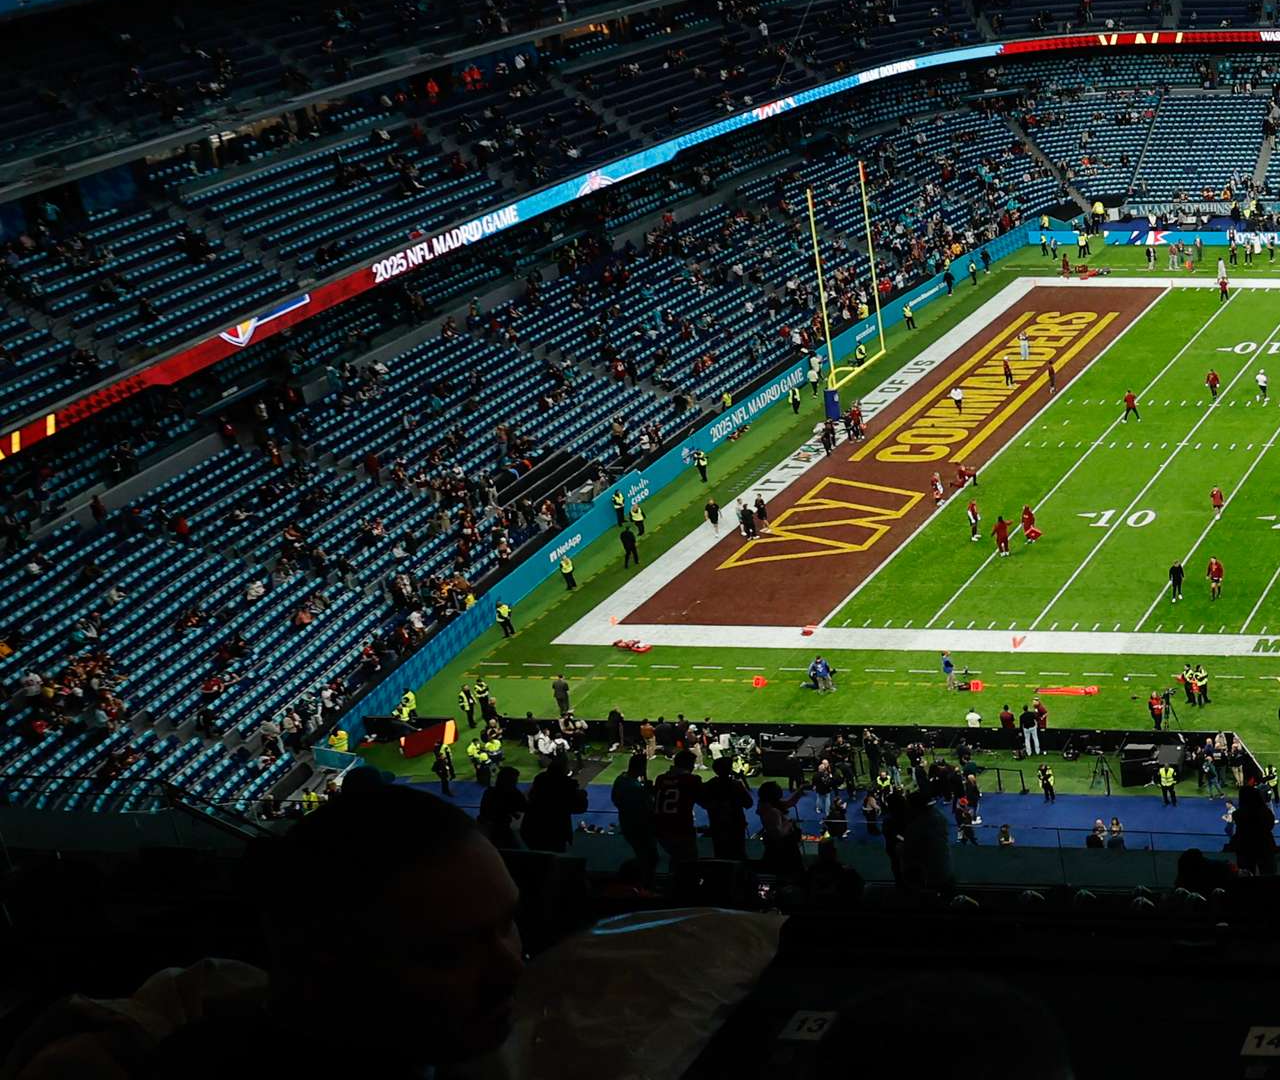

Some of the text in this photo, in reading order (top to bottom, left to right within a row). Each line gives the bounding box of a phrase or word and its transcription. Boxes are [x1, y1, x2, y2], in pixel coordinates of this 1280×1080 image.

[372, 204, 519, 283] 2025 NFL MADRID GAME
[874, 311, 1098, 462] COMMANDERS
[878, 359, 935, 394] OF US
[710, 367, 804, 442] 2025 NFL MADRID GAME
[753, 478, 786, 493] IT
[1090, 509, 1157, 529] 10
[557, 533, 582, 557] NetApp
[795, 1016, 828, 1033] 13
